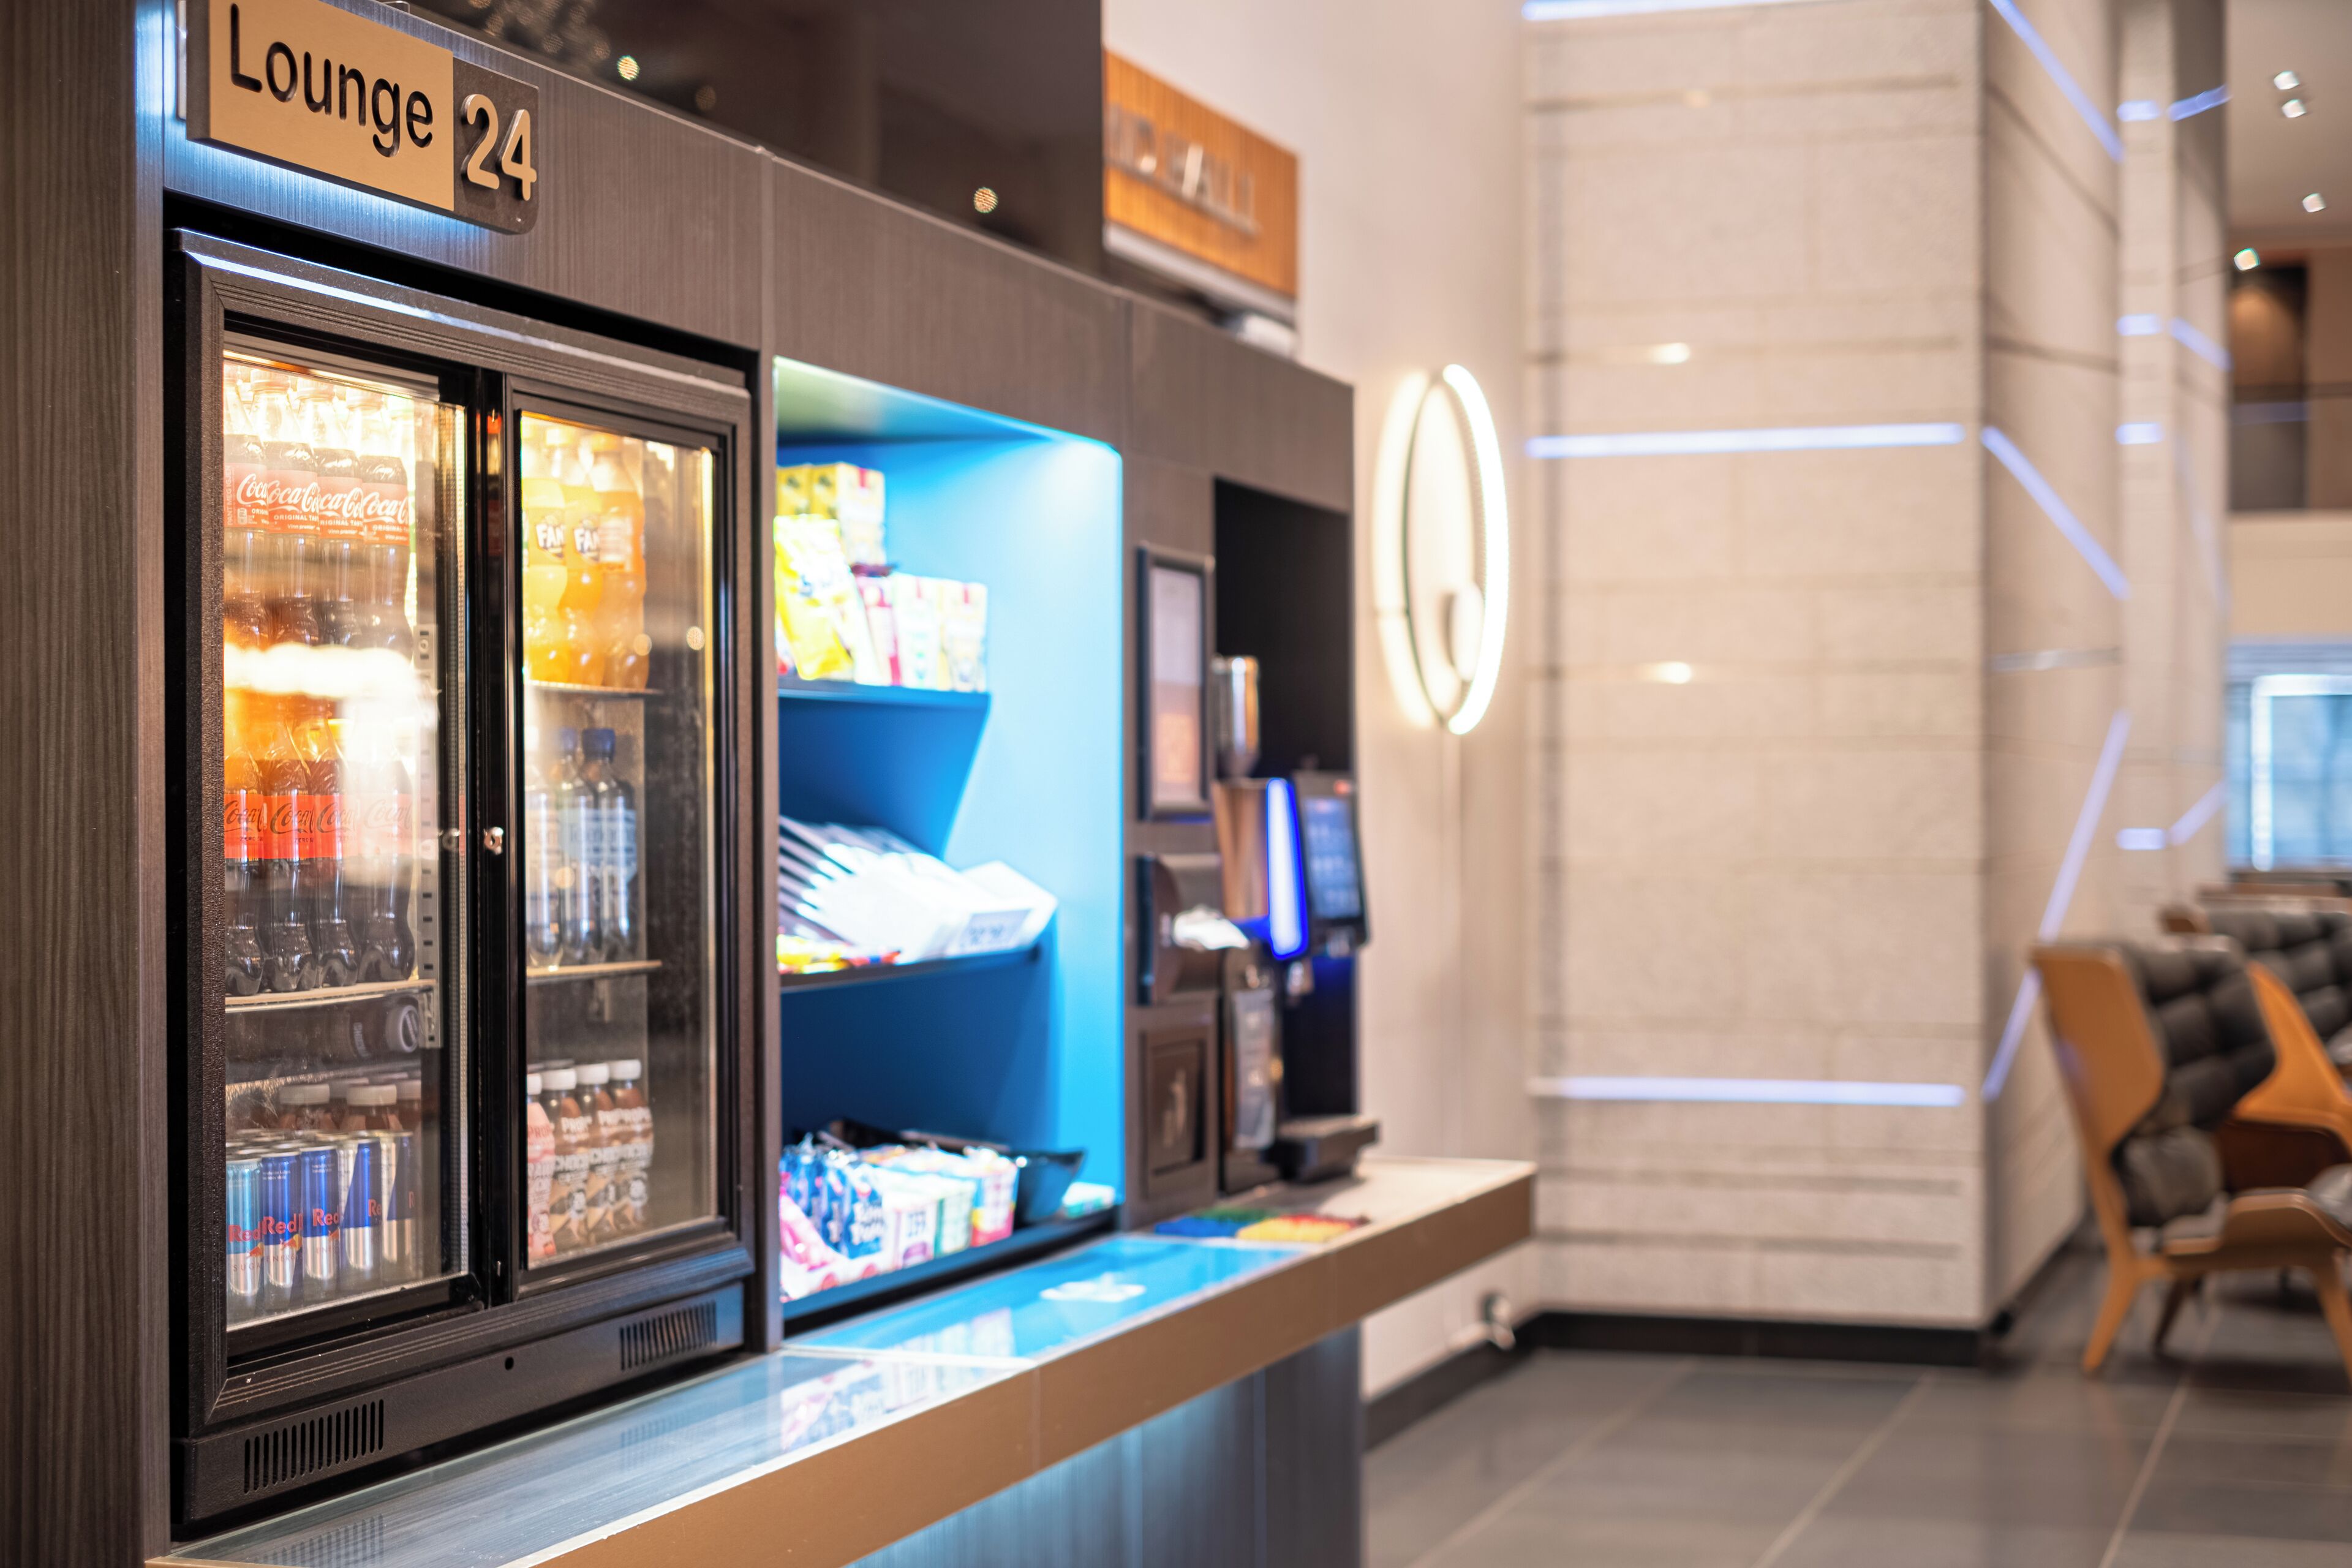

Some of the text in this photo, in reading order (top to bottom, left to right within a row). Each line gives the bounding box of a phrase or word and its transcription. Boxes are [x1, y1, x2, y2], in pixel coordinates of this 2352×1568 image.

[230, 2, 538, 202] Lounge 24
[228, 1221, 262, 1243] Red
[262, 1213, 297, 1235] Red
